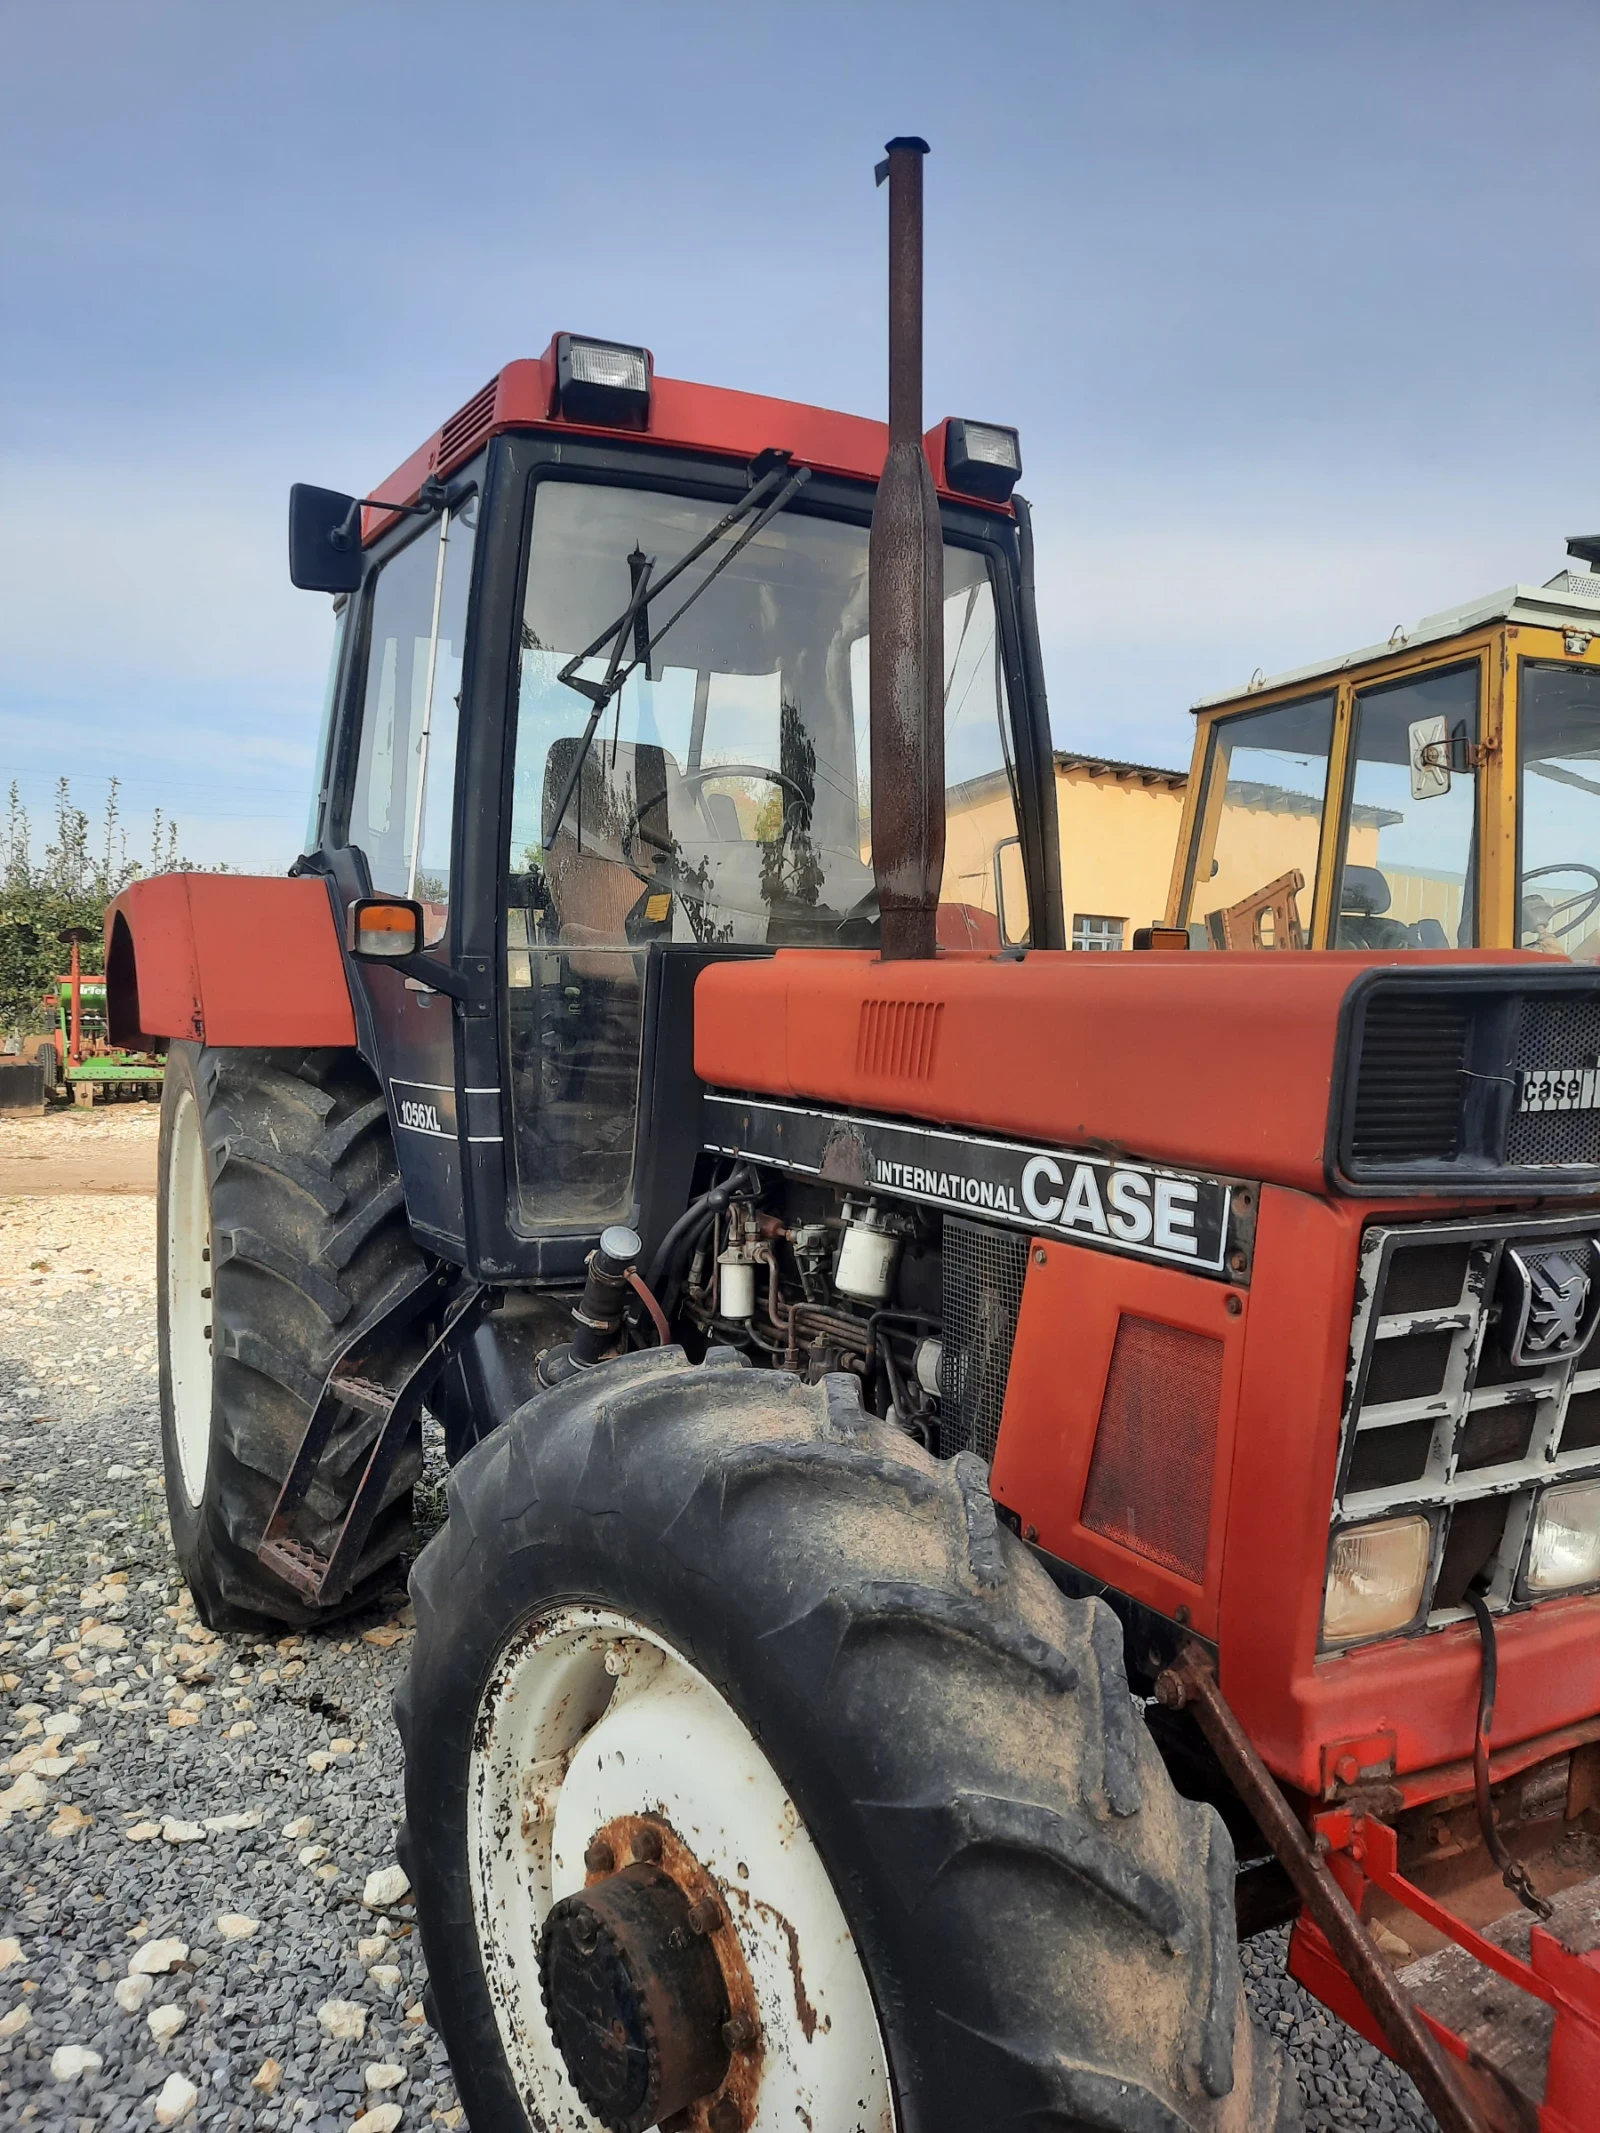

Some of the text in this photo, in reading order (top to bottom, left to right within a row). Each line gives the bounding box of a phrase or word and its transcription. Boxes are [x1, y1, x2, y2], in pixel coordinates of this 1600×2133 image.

[401, 1100, 441, 1132] 1056XL
[877, 1155, 1198, 1255] INTERNATIONAL CASE
